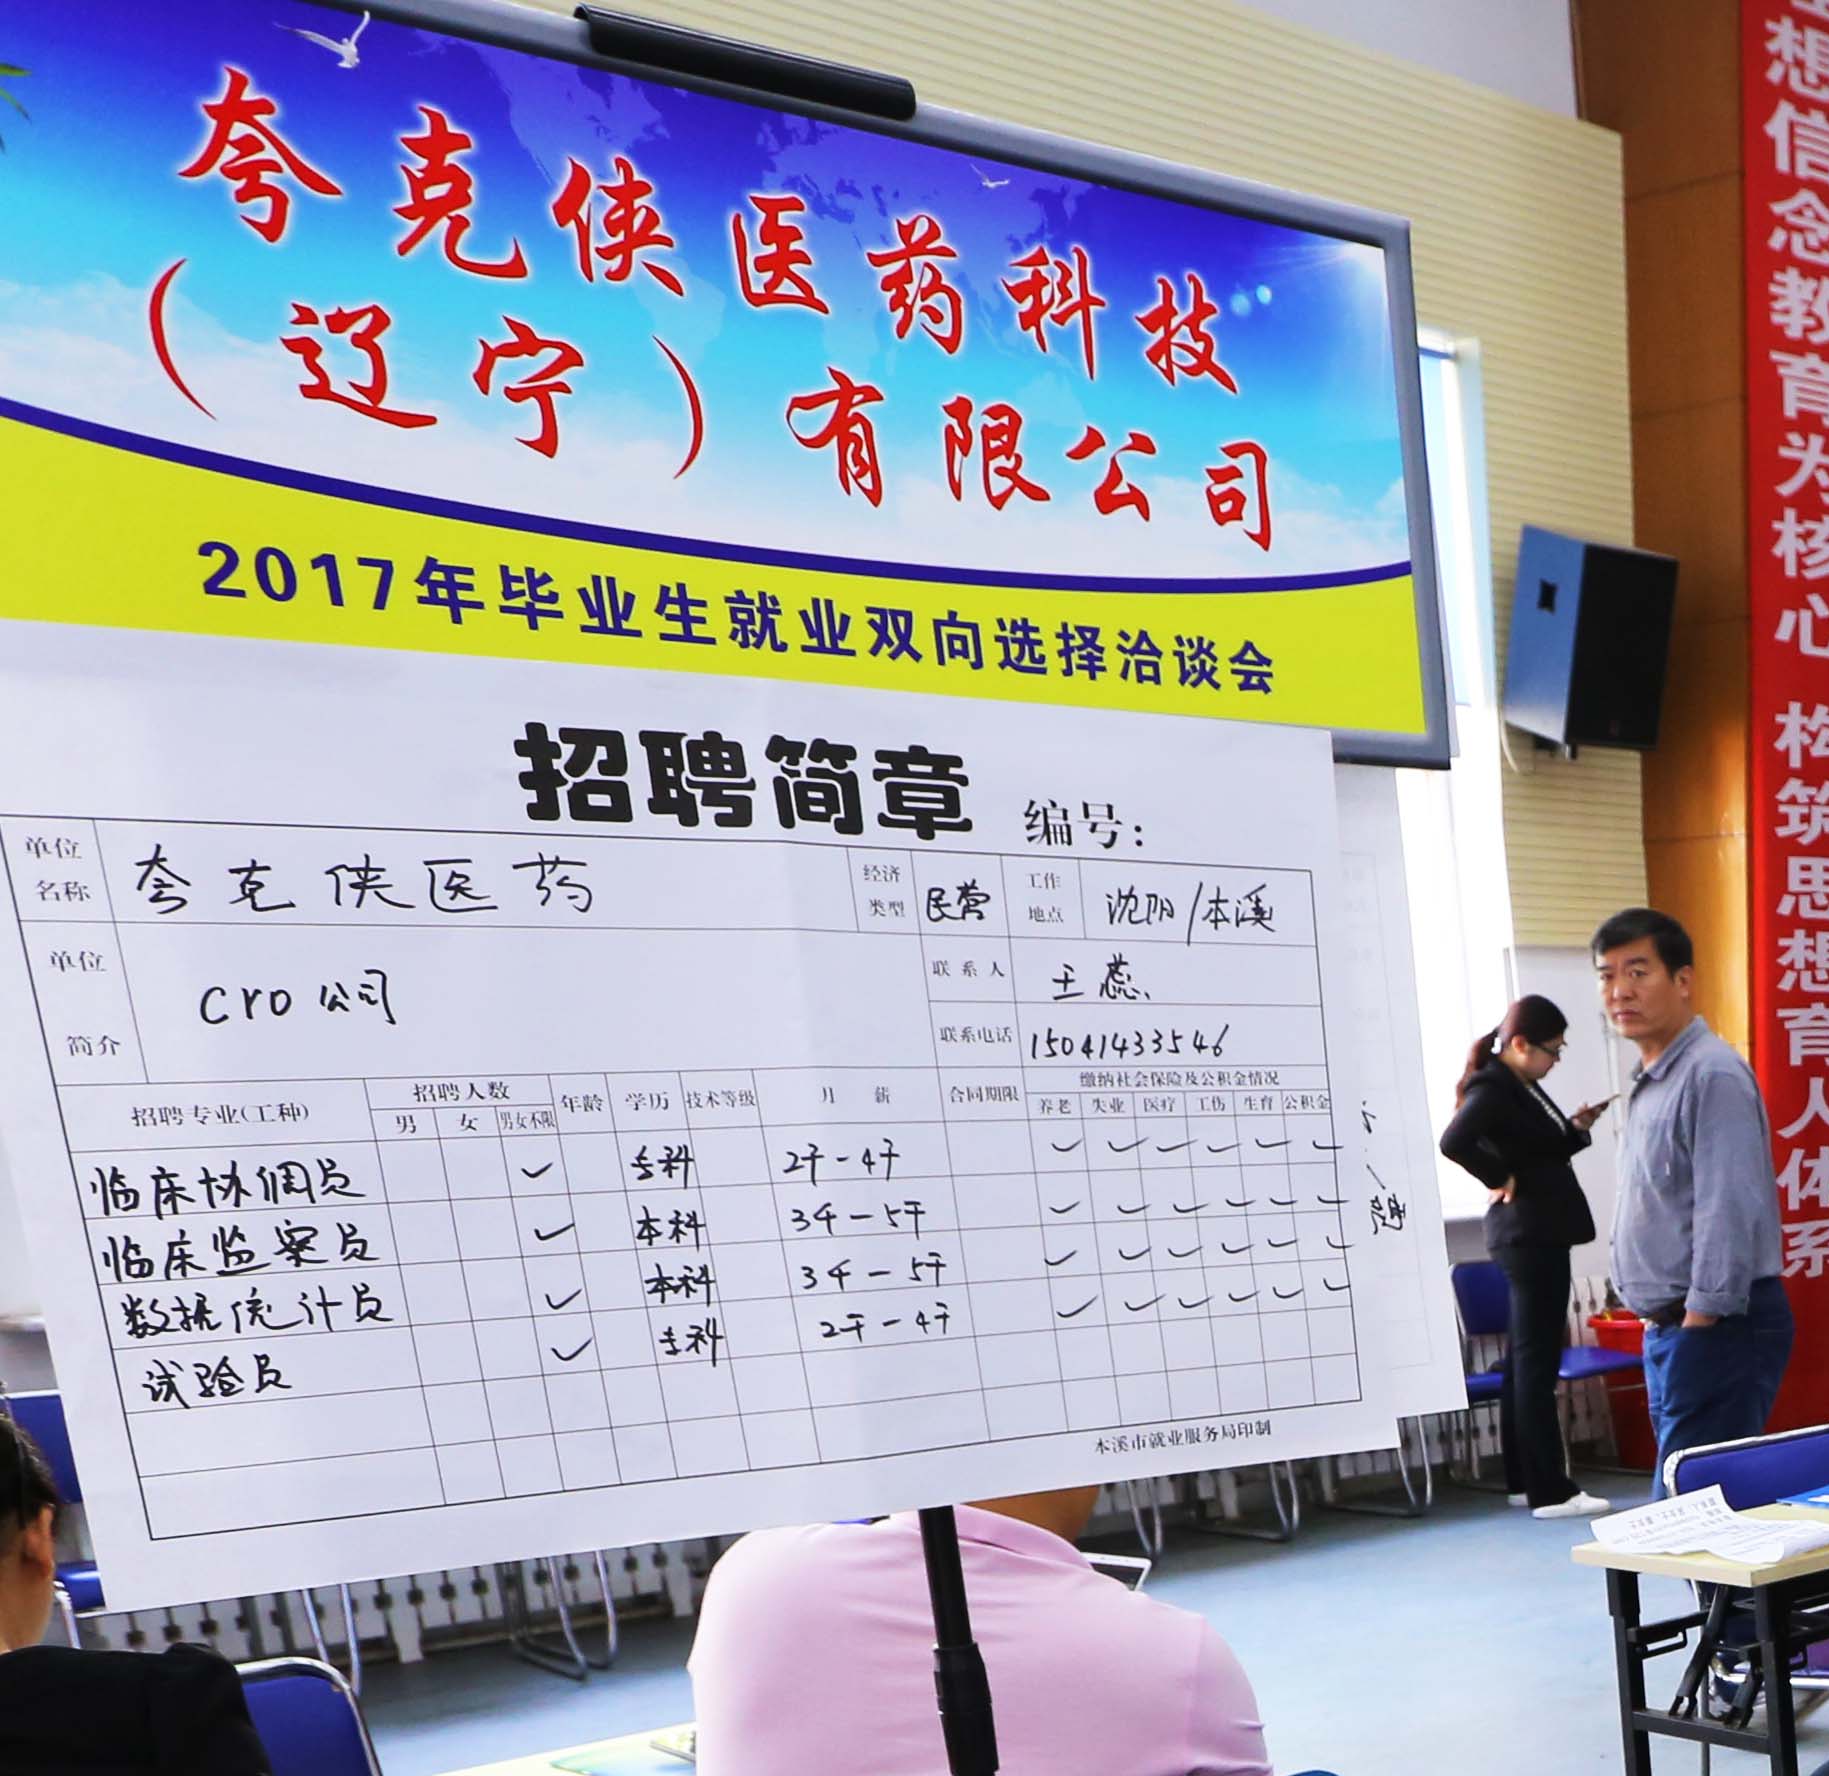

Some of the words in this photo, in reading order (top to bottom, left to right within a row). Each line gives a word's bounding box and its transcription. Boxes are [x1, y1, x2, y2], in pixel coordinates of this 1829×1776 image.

[178, 67, 1238, 395] 夸克侠医药科技
[149, 257, 1273, 552] （辽宁）有限公司
[197, 541, 1274, 696] 2017年毕业生就业双向选择洽谈会
[512, 721, 975, 841] 招聘简章
[25, 835, 81, 862] 单位
[134, 844, 593, 914] 夸克侠医药
[863, 863, 901, 884] 经济
[1026, 872, 1062, 892] 工作
[35, 879, 91, 903] 名称
[869, 898, 906, 918] 类型
[1027, 905, 1064, 924] 地点
[50, 950, 107, 974] 单位
[932, 959, 1005, 981] 联系人
[319, 968, 397, 1025] 公司
[67, 1035, 121, 1058] 简介
[940, 1024, 1013, 1046] 联系电话
[412, 1079, 511, 1103] 招聘人数
[1079, 1070, 1281, 1089] 缴纳社会保险及公积金情况
[560, 1092, 604, 1114] 年龄
[625, 1088, 669, 1111] 学历
[686, 1088, 756, 1109] 技术等级
[949, 1086, 1020, 1103] 合同期限
[1039, 1096, 1072, 1115] 养老
[1092, 1096, 1126, 1115] 失业
[1144, 1095, 1177, 1114] 医疗
[1196, 1094, 1227, 1113] 工伤
[1243, 1094, 1275, 1113] 生育
[1283, 1093, 1331, 1113] 公积金
[131, 1103, 310, 1130] 招聘专业(工种)
[395, 1112, 417, 1135] 男
[459, 1110, 481, 1132] 女
[499, 1108, 556, 1131] 男女不限
[635, 1206, 706, 1252] 本科
[143, 1353, 293, 1410] 试验员
[1094, 1419, 1273, 1456] 本溪市就业服务局印制
